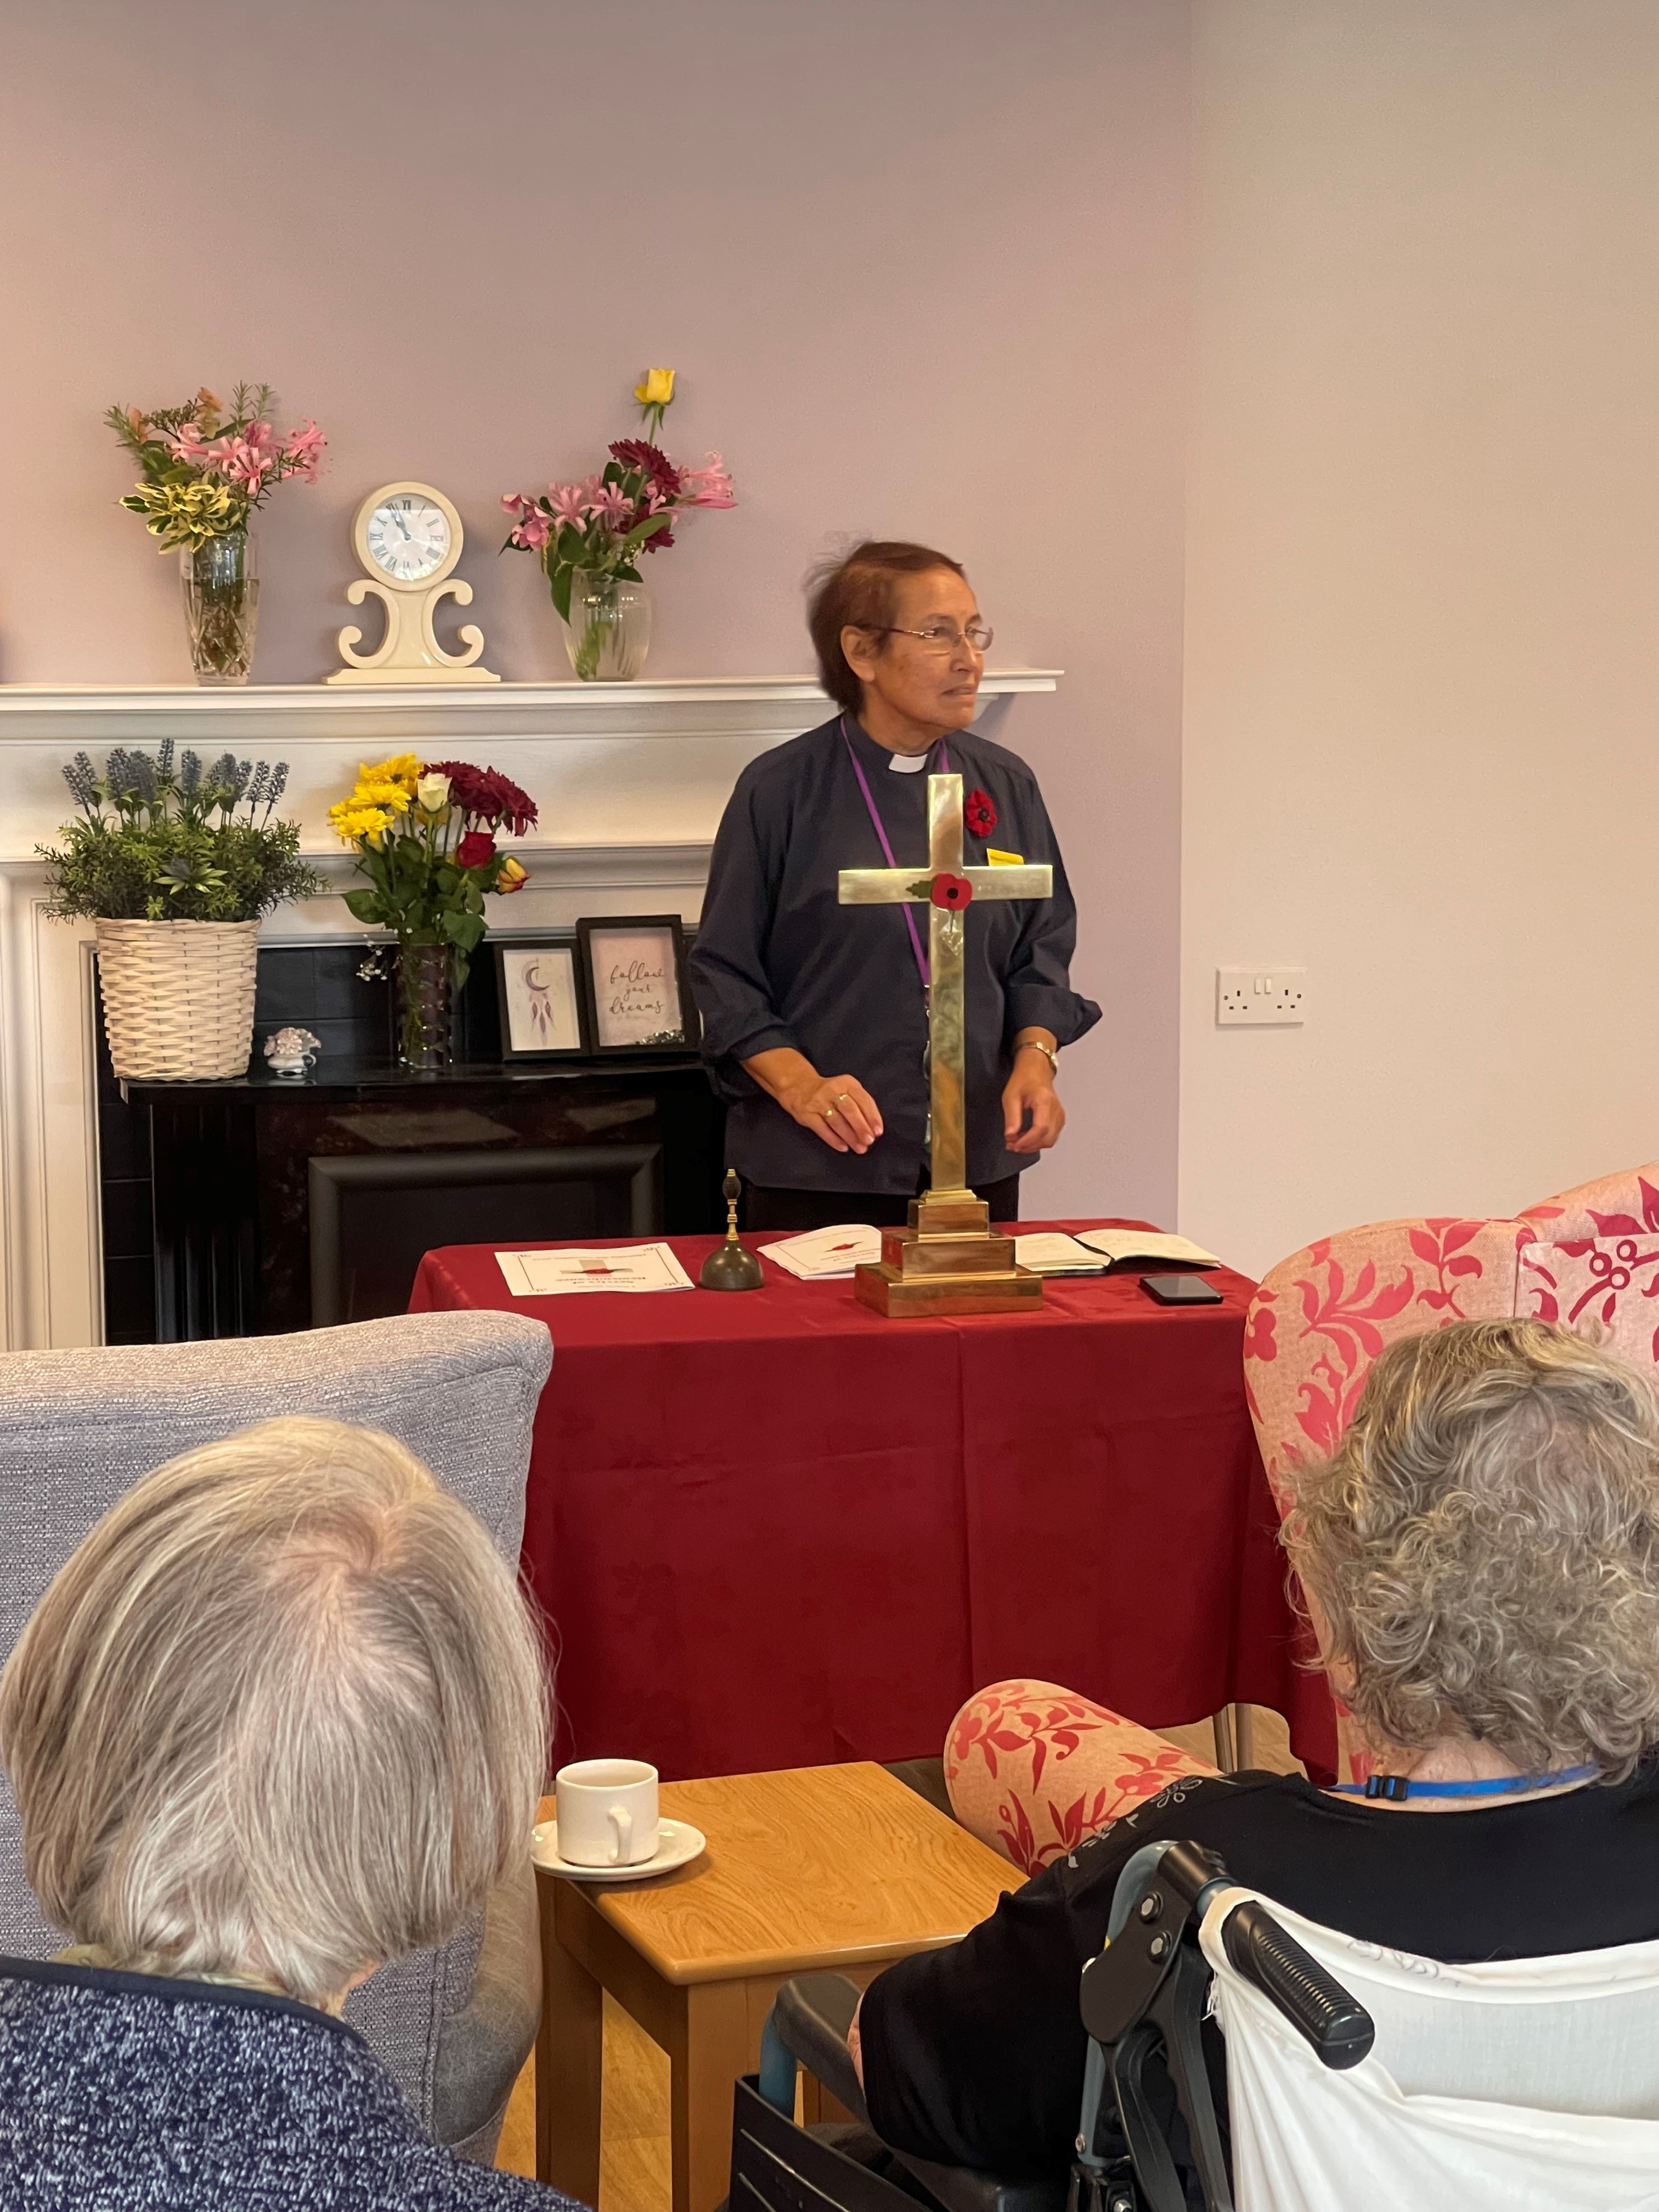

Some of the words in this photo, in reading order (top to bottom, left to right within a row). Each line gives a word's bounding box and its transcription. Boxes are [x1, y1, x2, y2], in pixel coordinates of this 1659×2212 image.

[610, 960, 664, 984] follow
[623, 984, 653, 1001] your
[610, 996, 663, 1014] dreams
